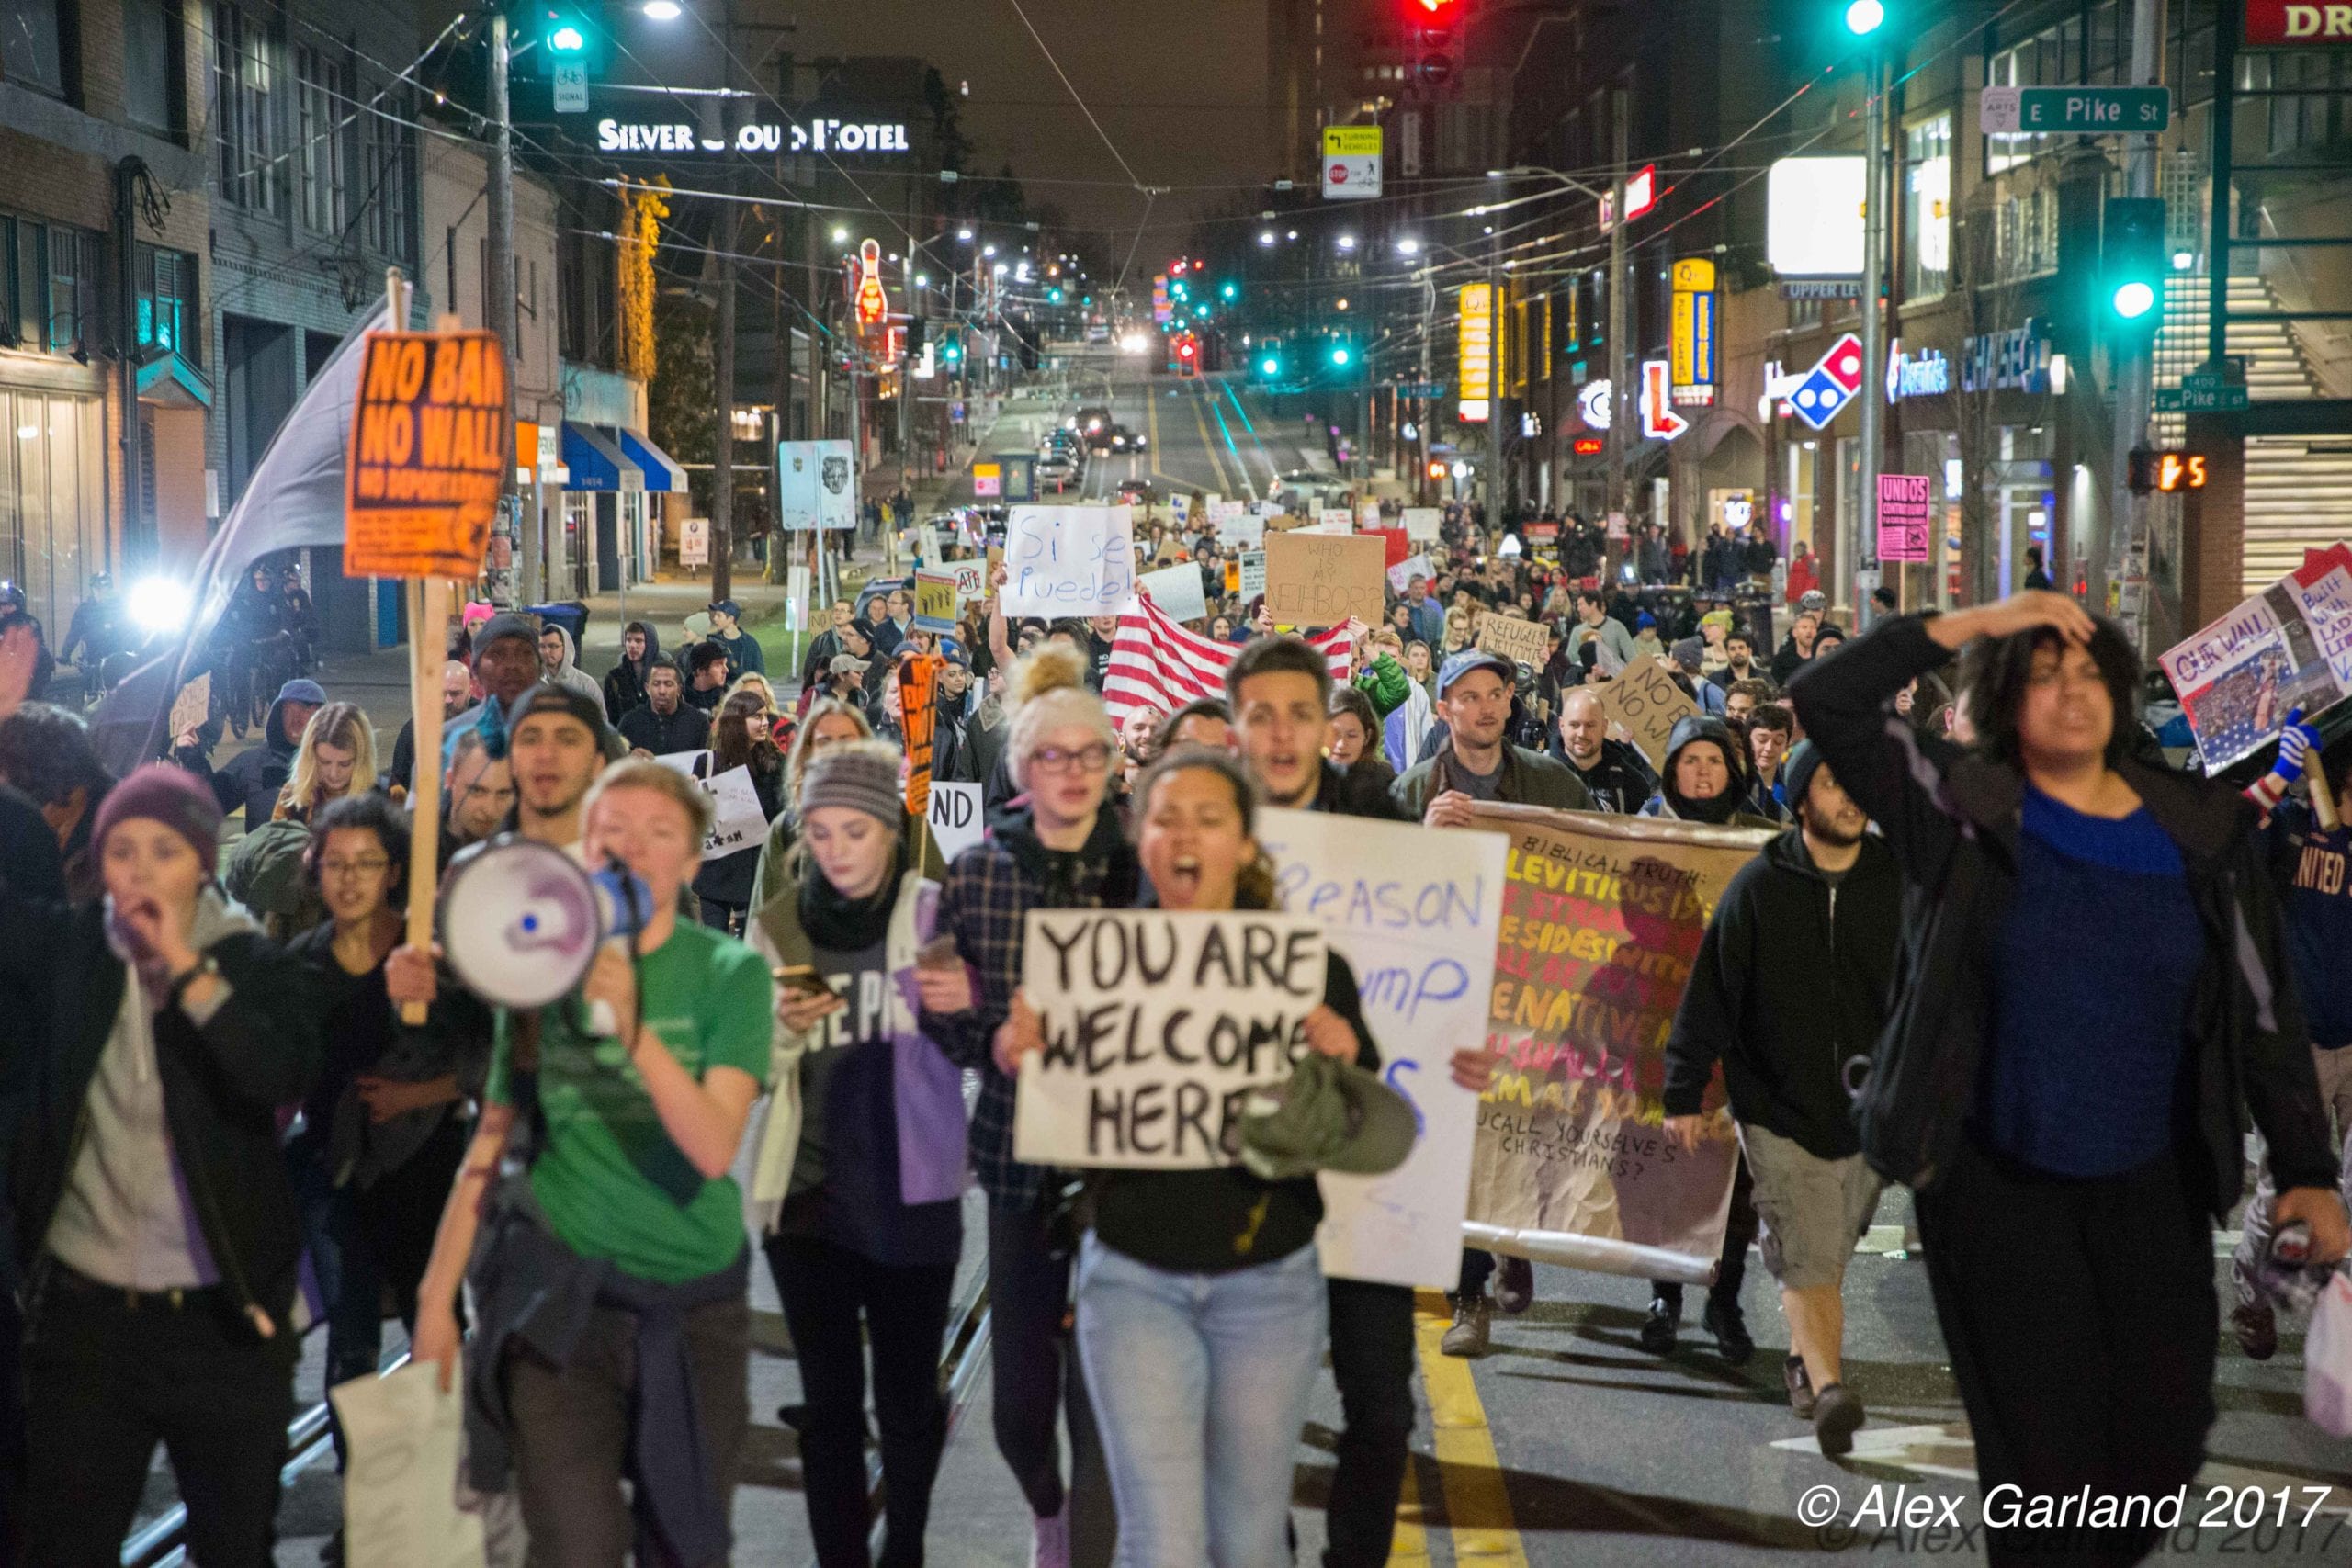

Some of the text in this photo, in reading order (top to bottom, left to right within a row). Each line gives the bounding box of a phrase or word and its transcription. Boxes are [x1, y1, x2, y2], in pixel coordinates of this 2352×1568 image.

[557, 93, 583, 101] SIGNAL
[2030, 97, 2158, 121] E Pike St
[598, 119, 695, 151] SILVER
[1791, 282, 1838, 299] UPPER
[368, 340, 426, 401] NO
[2182, 389, 2215, 406] Pike
[361, 404, 502, 468] NO WALL
[1090, 534, 1125, 564] se
[1308, 543, 1343, 557] WHO
[1319, 558, 1333, 569] IS
[1020, 566, 1132, 604] Puede!
[1312, 569, 1336, 581] MY
[2319, 616, 2352, 643] LAD
[1608, 679, 1645, 717] NO
[1634, 666, 1672, 706] NO
[1521, 835, 1623, 874] BIBLICAL
[2293, 845, 2346, 896] NITED
[1038, 919, 1323, 996] YOU ARE
[1039, 1001, 1309, 1077] WELCOME
